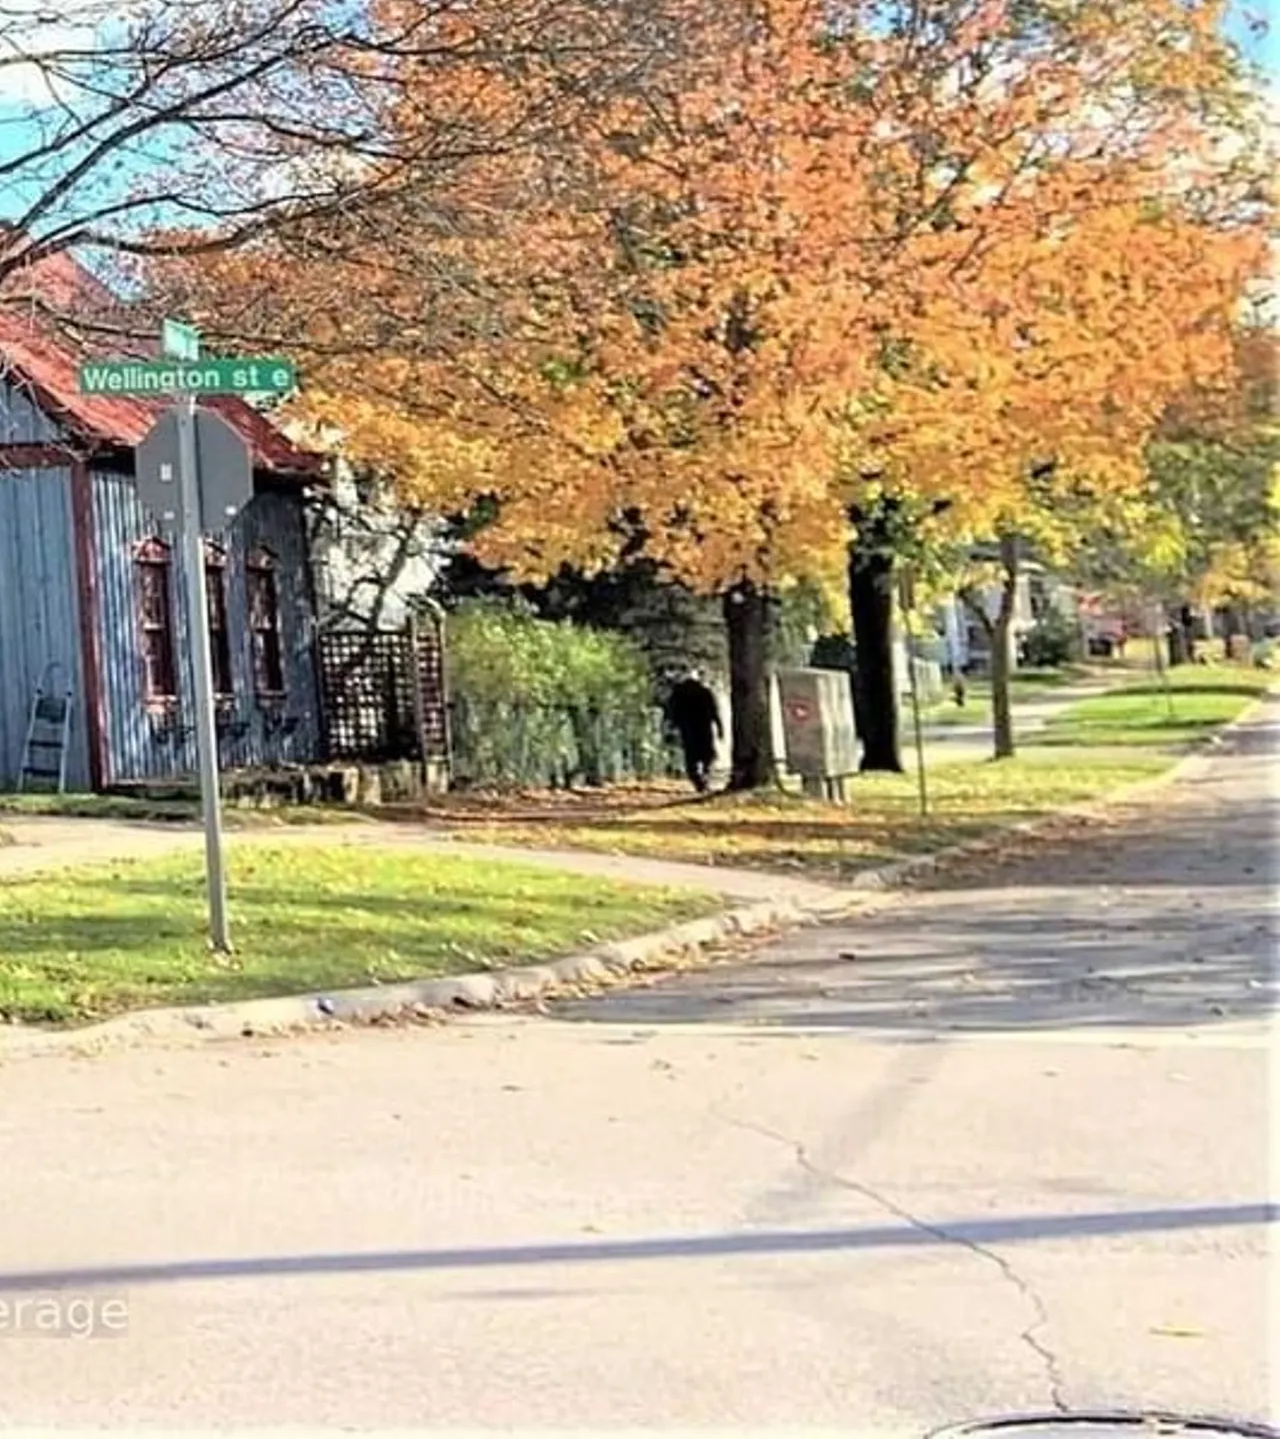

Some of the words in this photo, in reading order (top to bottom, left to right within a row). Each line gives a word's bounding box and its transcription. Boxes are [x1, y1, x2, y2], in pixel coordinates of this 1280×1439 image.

[83, 367, 220, 391] Wellington
[232, 365, 259, 387] st
[272, 368, 288, 387] e
